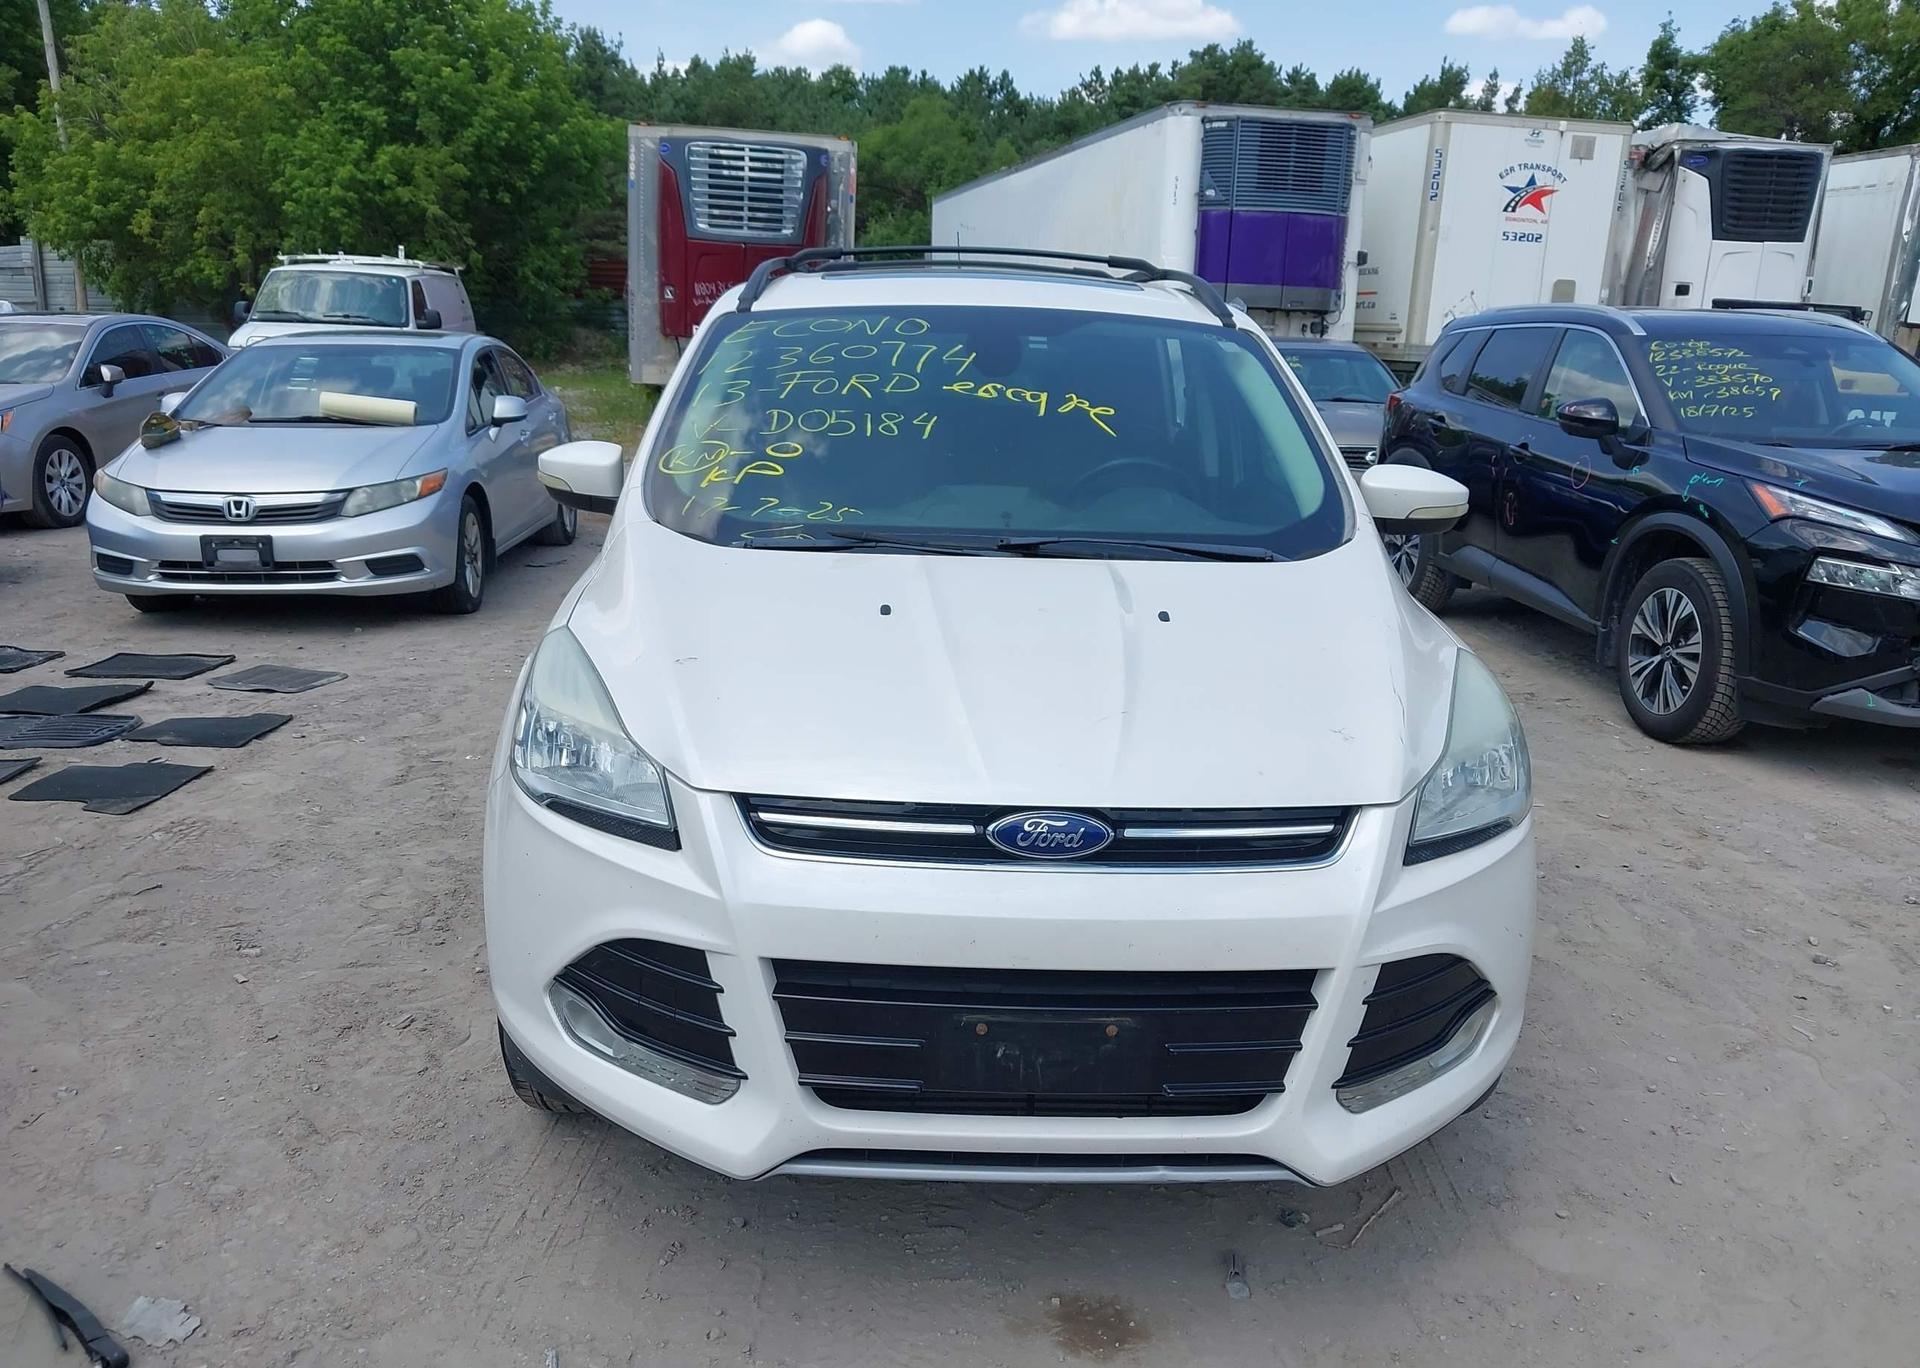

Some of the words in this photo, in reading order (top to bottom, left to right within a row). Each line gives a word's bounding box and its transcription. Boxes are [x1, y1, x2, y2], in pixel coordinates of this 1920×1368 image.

[1429, 148, 1443, 202] 53202
[1517, 162, 1568, 184] TRANSPORT
[1502, 231, 1543, 243] 53202
[724, 316, 931, 343] ECONO
[1016, 818, 1085, 848] Ford
